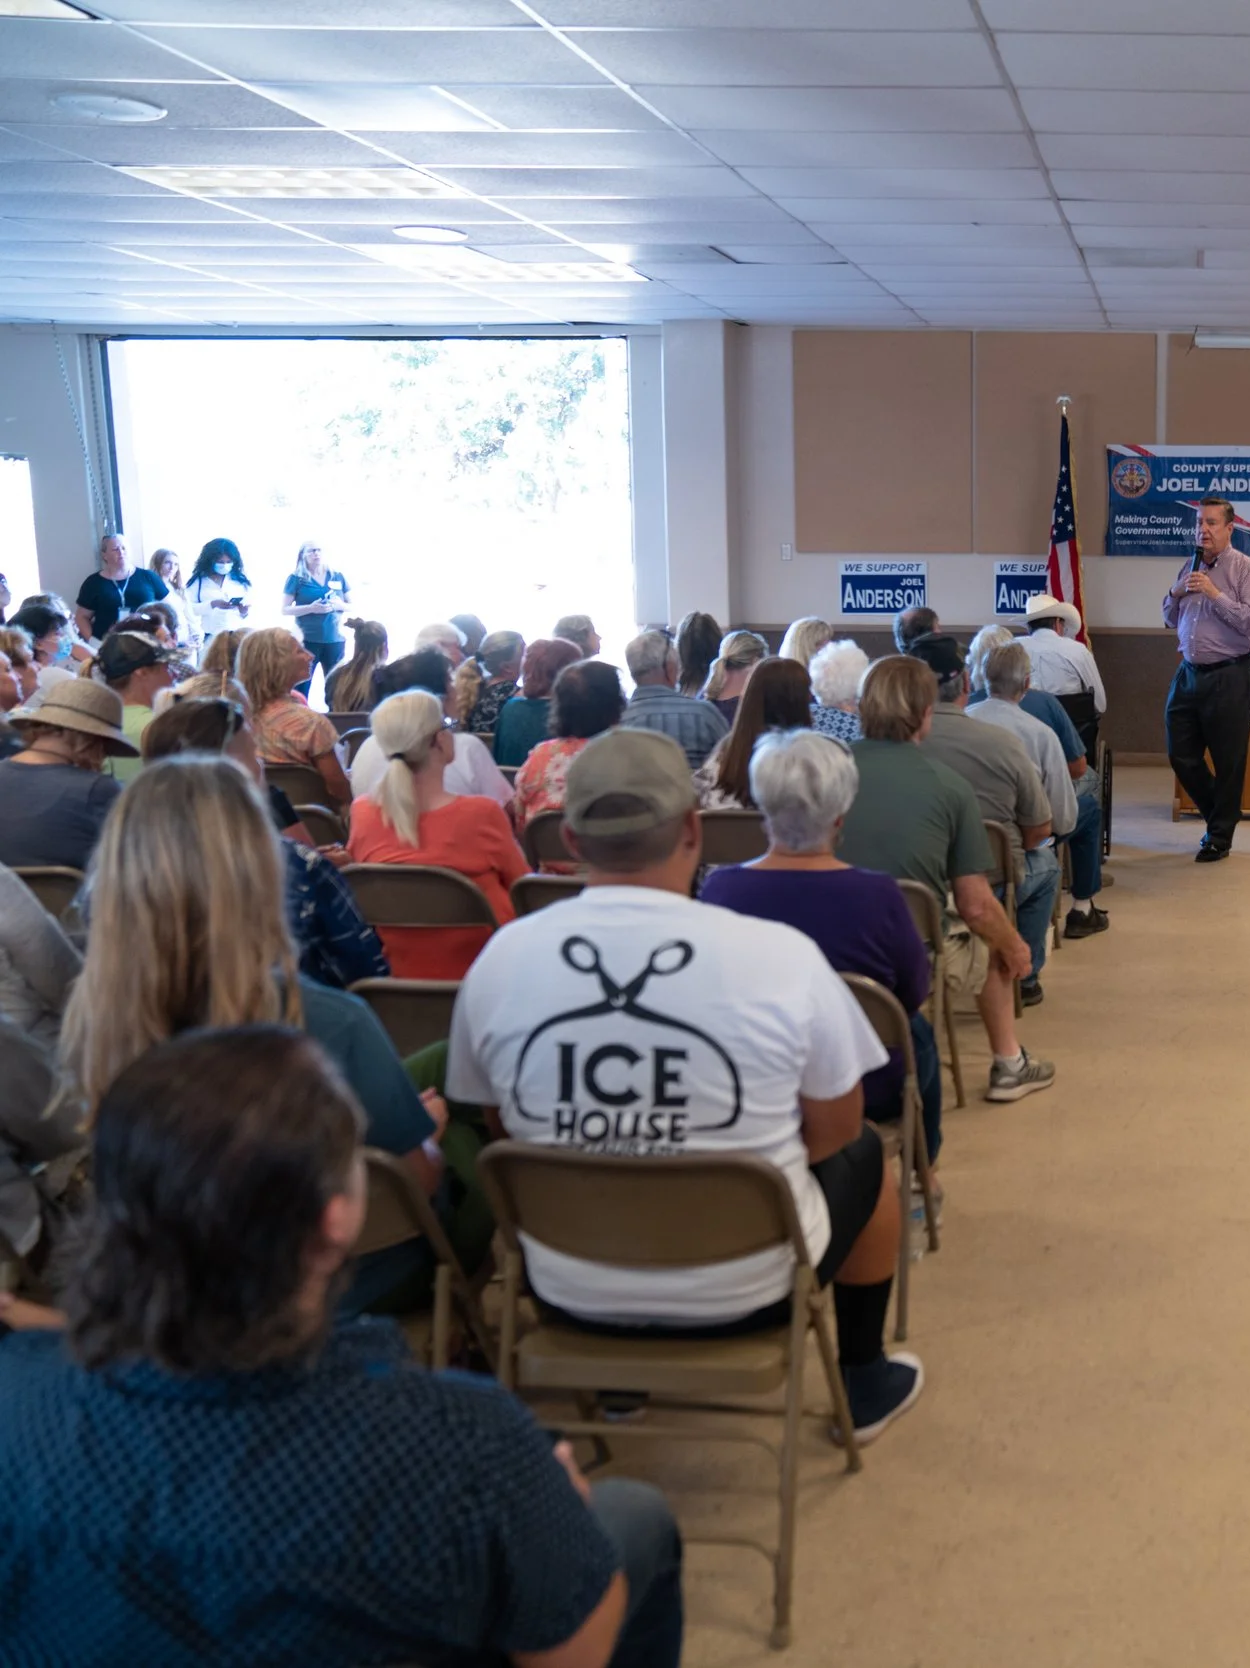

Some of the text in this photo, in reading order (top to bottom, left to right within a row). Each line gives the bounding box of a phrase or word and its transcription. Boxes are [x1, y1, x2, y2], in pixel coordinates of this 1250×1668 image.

[1172, 464, 1220, 473] COUNTY
[1156, 477, 1205, 492] JOEL
[1114, 515, 1182, 526] Making County
[1115, 526, 1170, 535] Government
[844, 563, 923, 572] WE SUPPORT
[1000, 563, 1018, 573] WE
[900, 578, 924, 586] JOEL
[843, 582, 924, 609] ANDERSON
[556, 1041, 689, 1107] ICE
[555, 1109, 689, 1143] HOUSE
